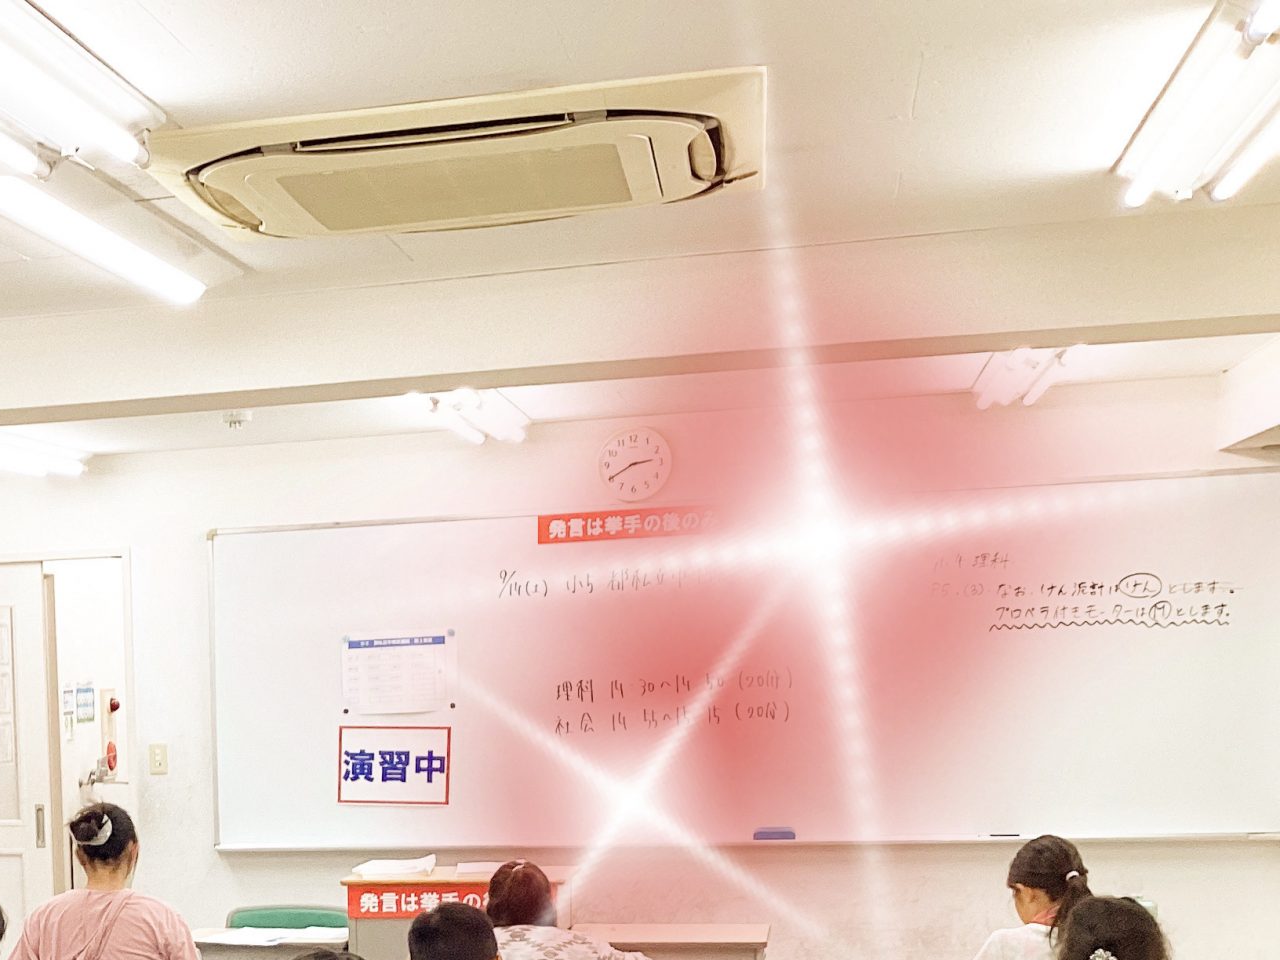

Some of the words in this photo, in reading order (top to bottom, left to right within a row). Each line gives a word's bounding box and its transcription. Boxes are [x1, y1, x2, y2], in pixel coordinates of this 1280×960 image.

[618, 439, 625, 447] 11
[629, 434, 638, 443] 12
[608, 449, 618, 458] 10
[630, 485, 637, 494] 6
[343, 749, 446, 783] 演習中
[359, 891, 489, 913] 発言は挙手の
